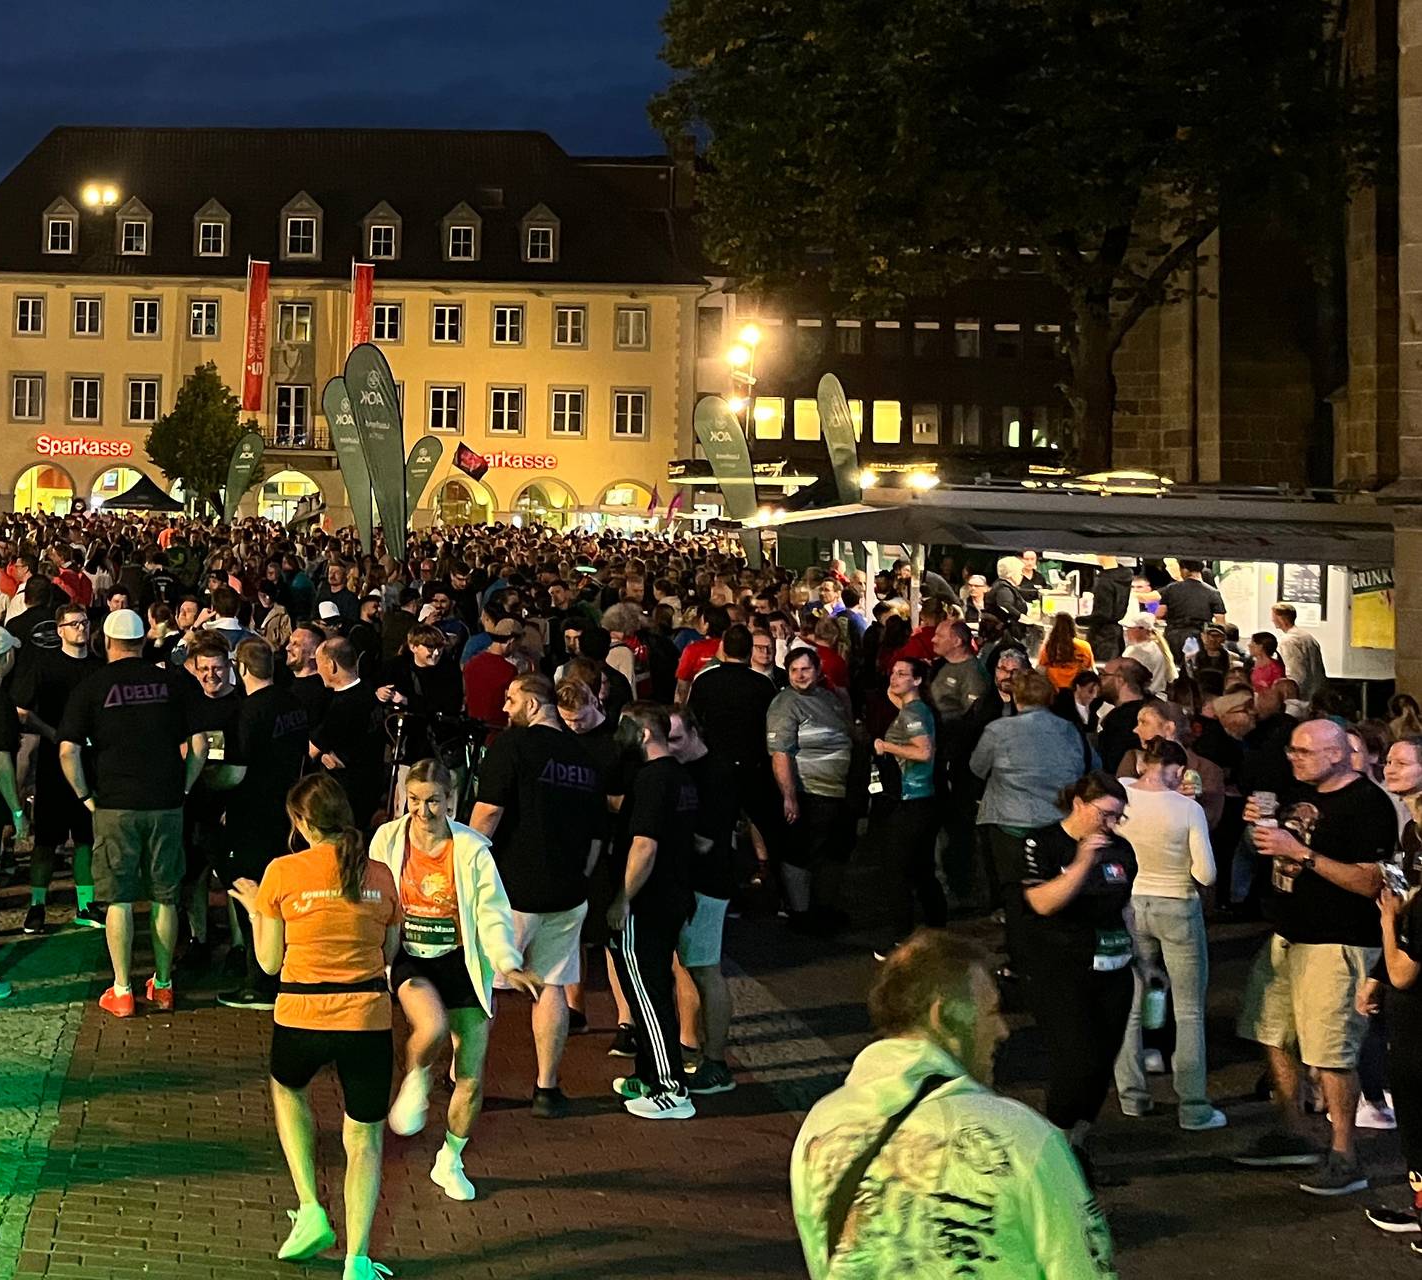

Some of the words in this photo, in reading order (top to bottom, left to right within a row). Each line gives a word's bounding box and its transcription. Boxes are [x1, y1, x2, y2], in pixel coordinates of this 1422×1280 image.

[36, 435, 132, 457] Sparkasse
[483, 451, 557, 469] arkasse
[1352, 568, 1395, 588] BRINK
[123, 684, 169, 700] DELTA
